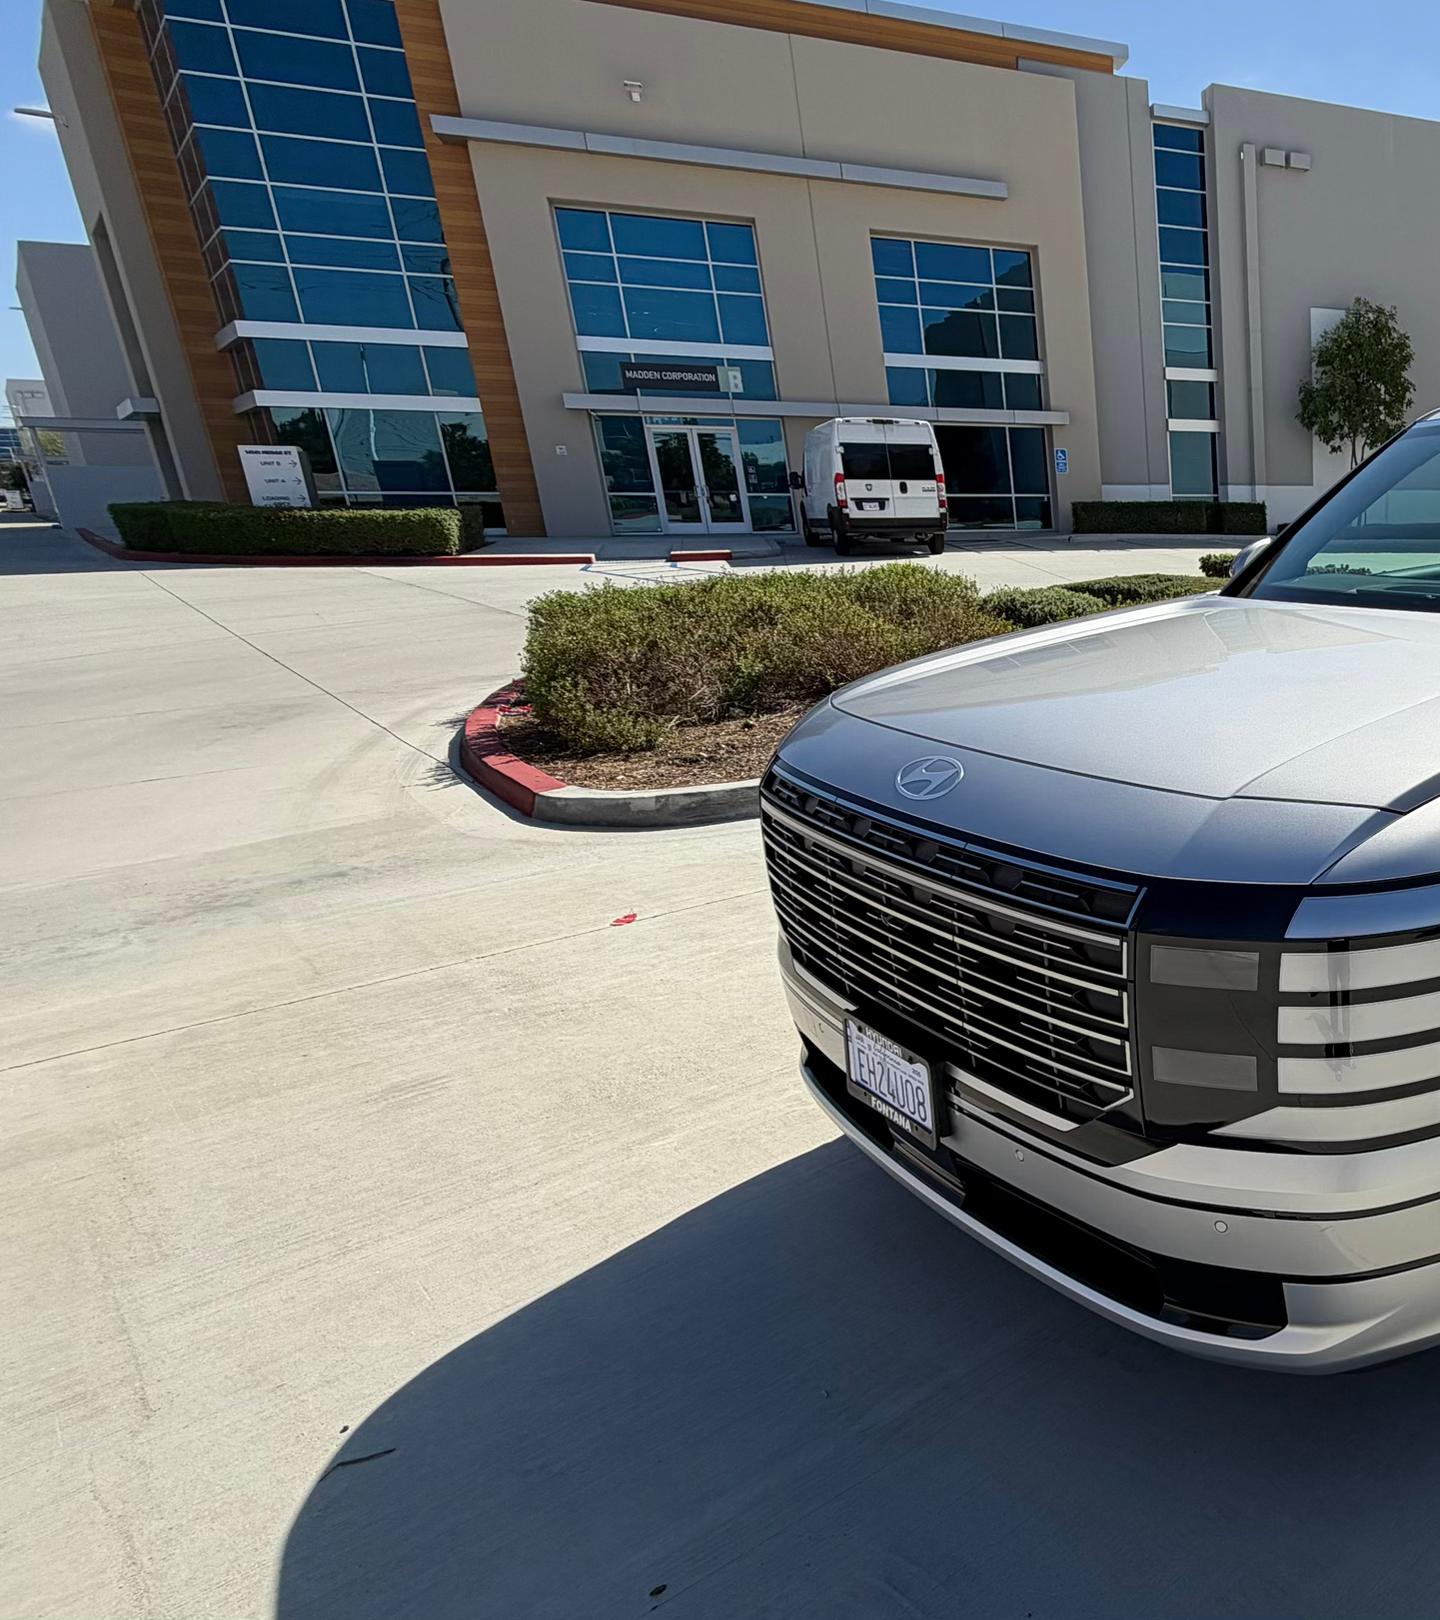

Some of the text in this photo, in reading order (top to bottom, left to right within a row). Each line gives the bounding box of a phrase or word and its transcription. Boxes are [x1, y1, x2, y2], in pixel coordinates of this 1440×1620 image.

[625, 369, 716, 382] MADDEN CORPORATION
[865, 1026, 903, 1059] HYUNDAI
[857, 1047, 927, 1123] EH24U08
[870, 1095, 912, 1133] FONTANA
